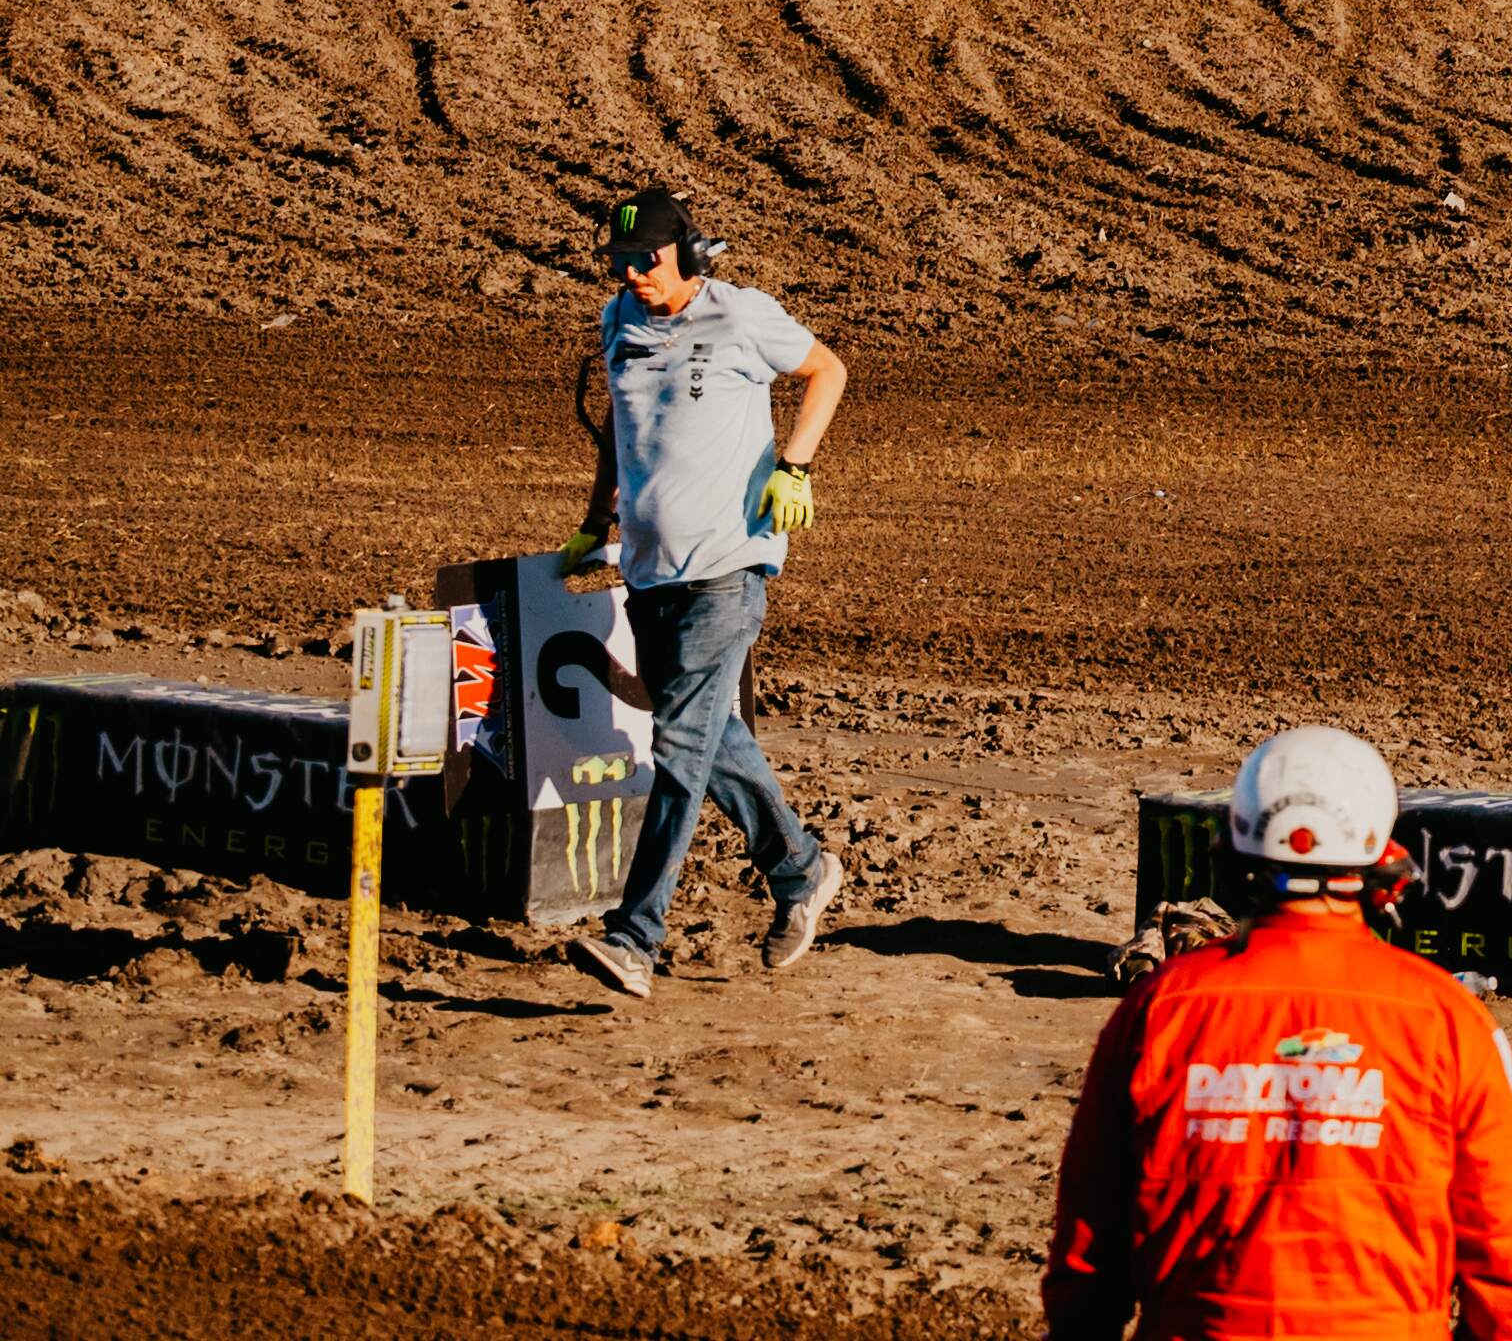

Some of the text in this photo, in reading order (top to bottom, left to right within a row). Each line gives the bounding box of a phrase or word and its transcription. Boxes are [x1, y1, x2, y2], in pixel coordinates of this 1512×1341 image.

[145, 818, 329, 865] ENERG
[1185, 1062, 1384, 1108] DAYTONA
[1187, 1118, 1384, 1148] FIRE RESCUE
